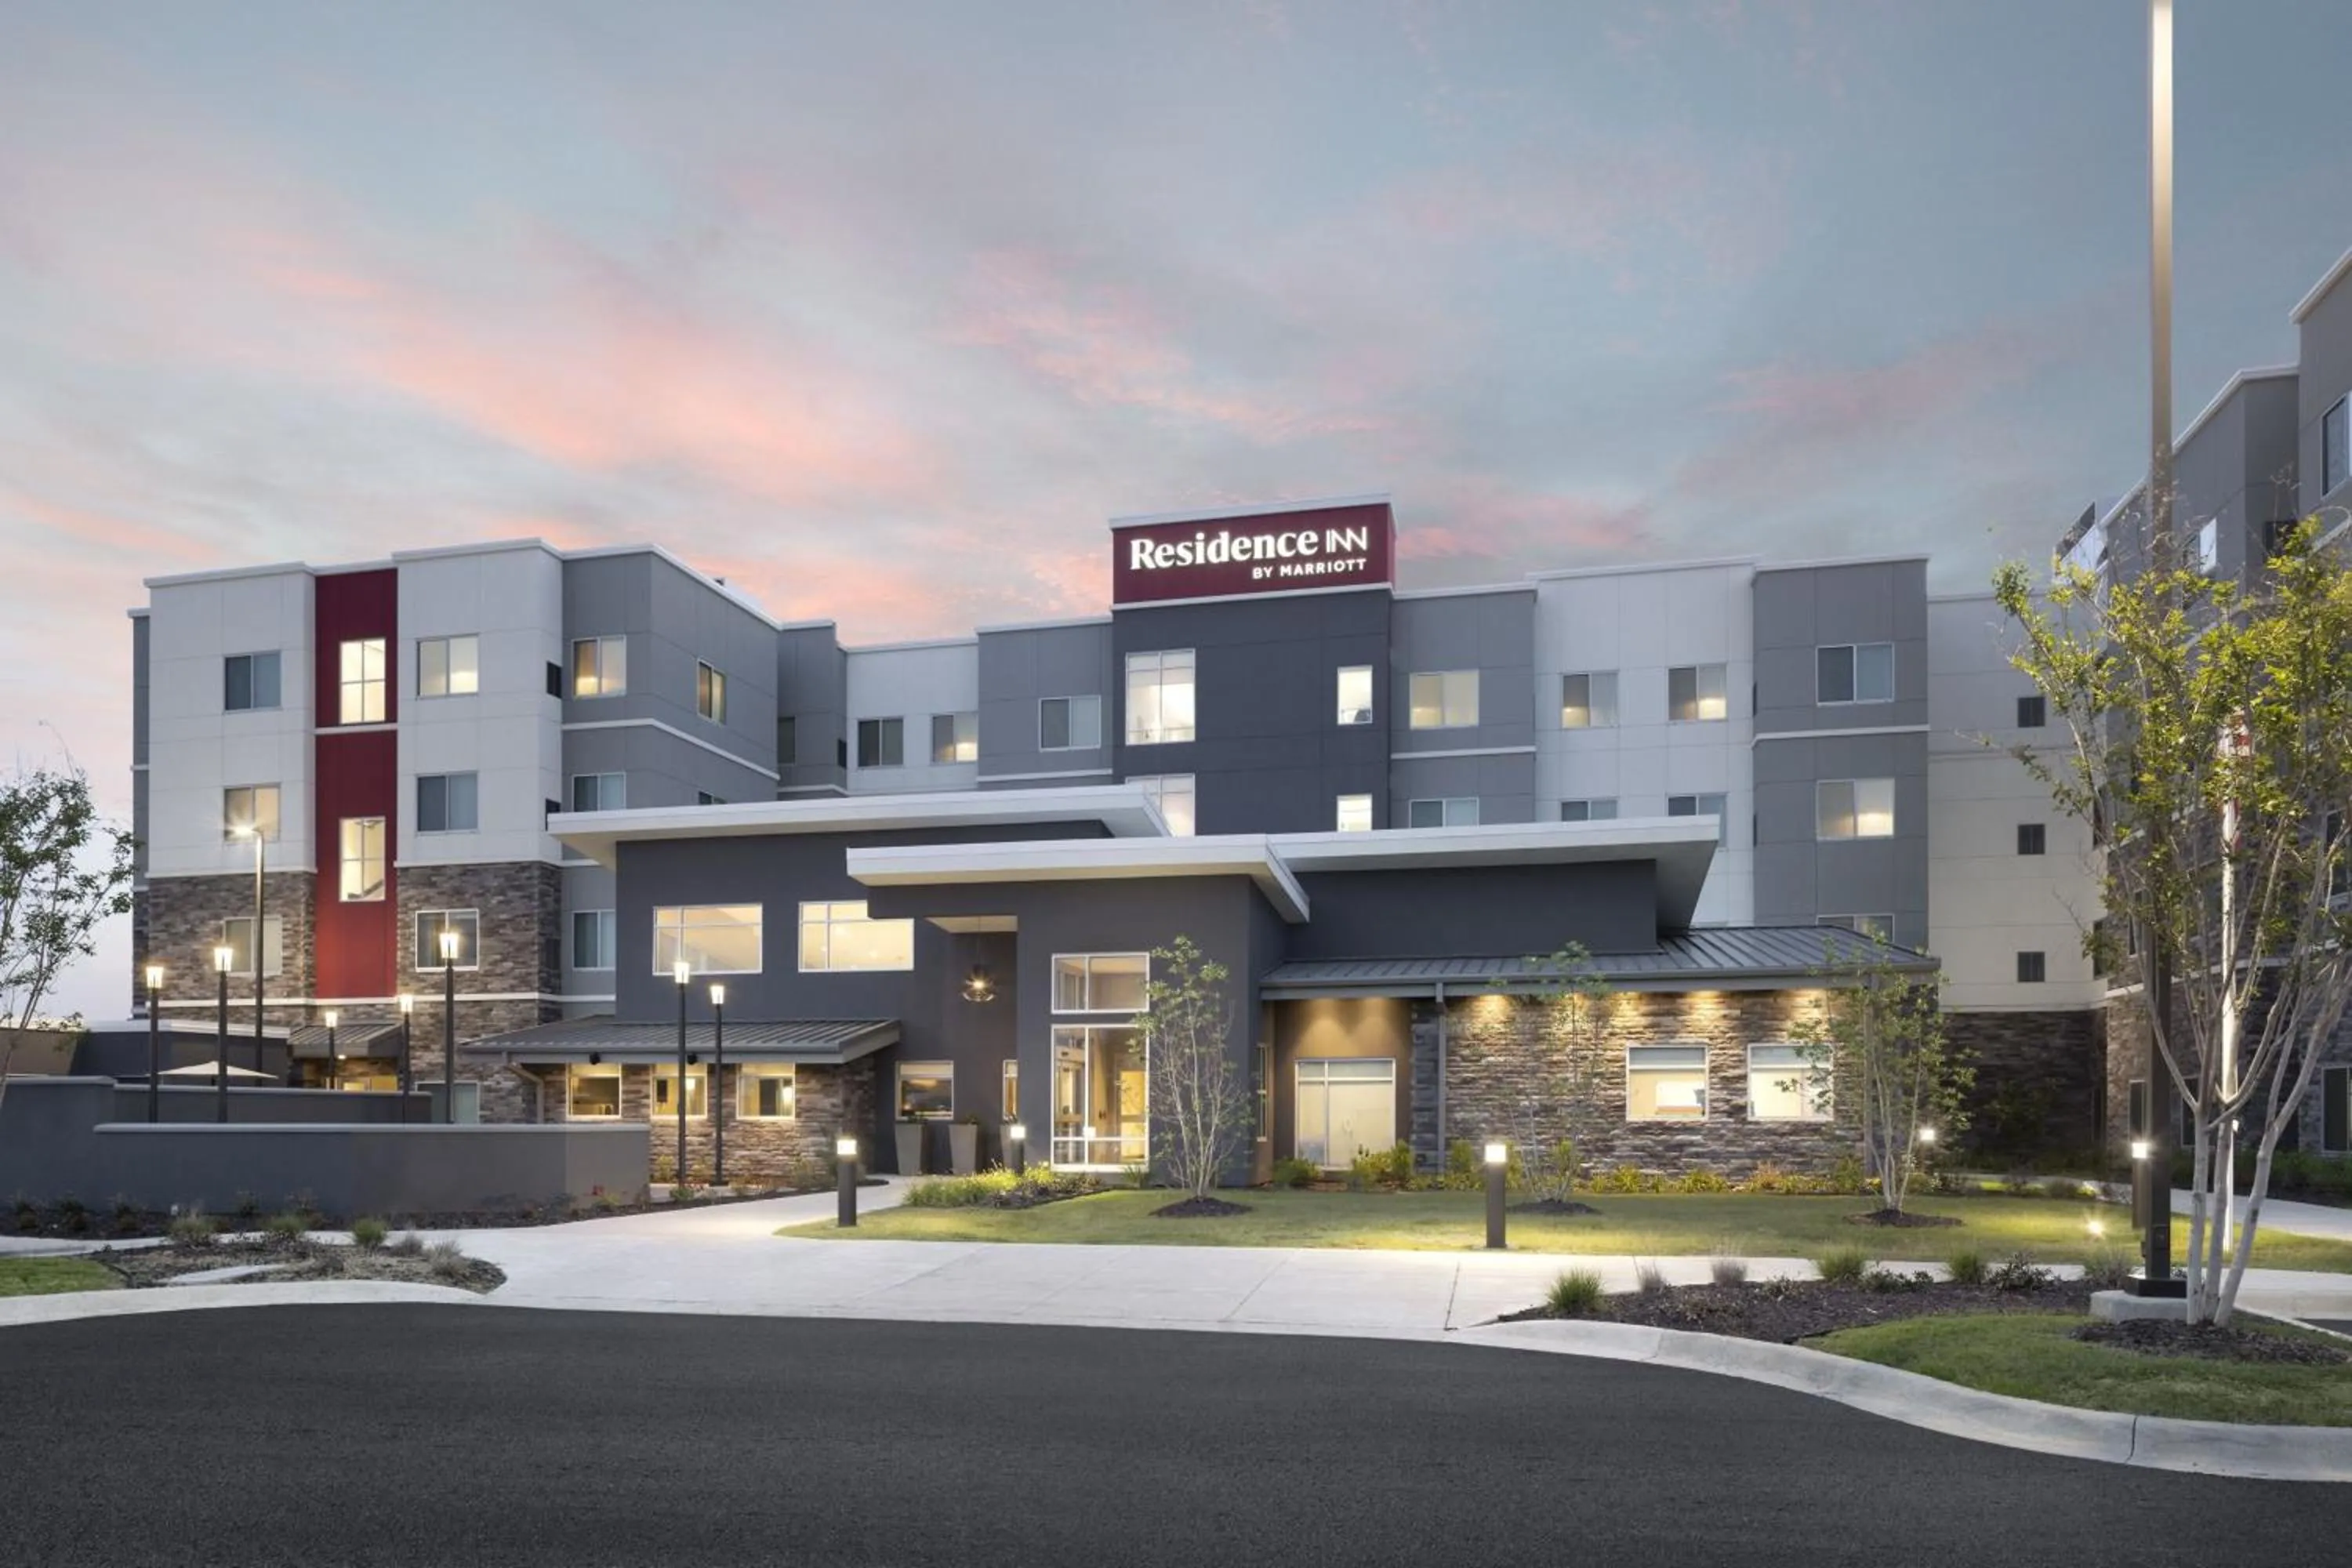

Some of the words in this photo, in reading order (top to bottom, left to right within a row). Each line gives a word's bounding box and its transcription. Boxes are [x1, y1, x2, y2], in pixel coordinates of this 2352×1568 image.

[1130, 531, 1319, 570] Residence
[1325, 526, 1368, 554] INN
[1252, 566, 1273, 579] BY
[1279, 557, 1367, 577] MARRIOTT
